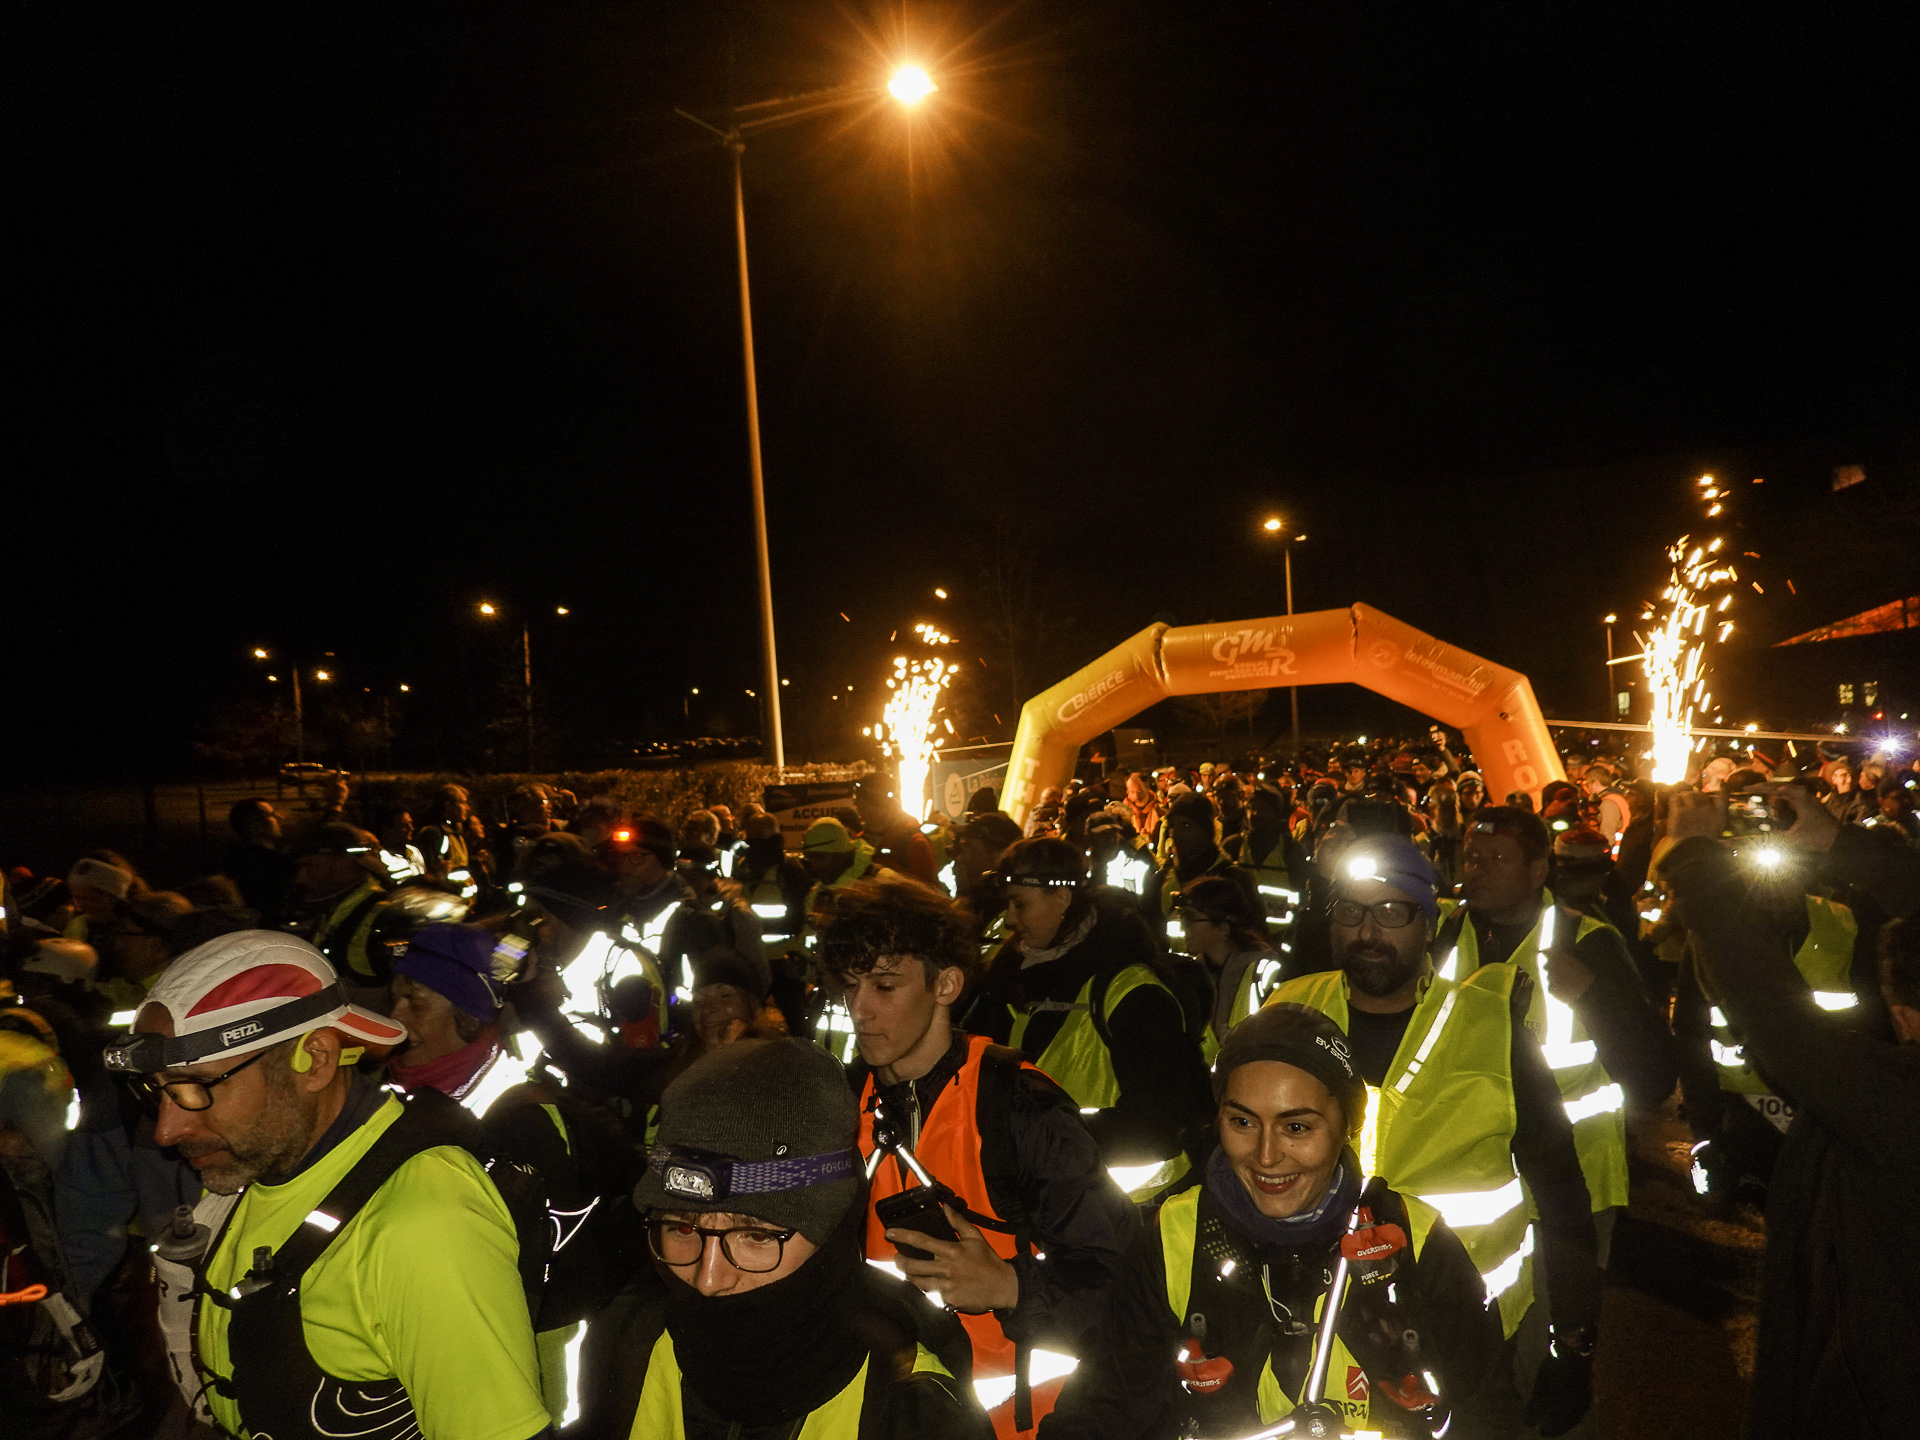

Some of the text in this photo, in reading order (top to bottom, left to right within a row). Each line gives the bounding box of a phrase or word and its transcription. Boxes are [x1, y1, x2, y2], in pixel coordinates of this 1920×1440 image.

[221, 1022, 265, 1047] PETZL
[1315, 1036, 1354, 1079] BV SPORT
